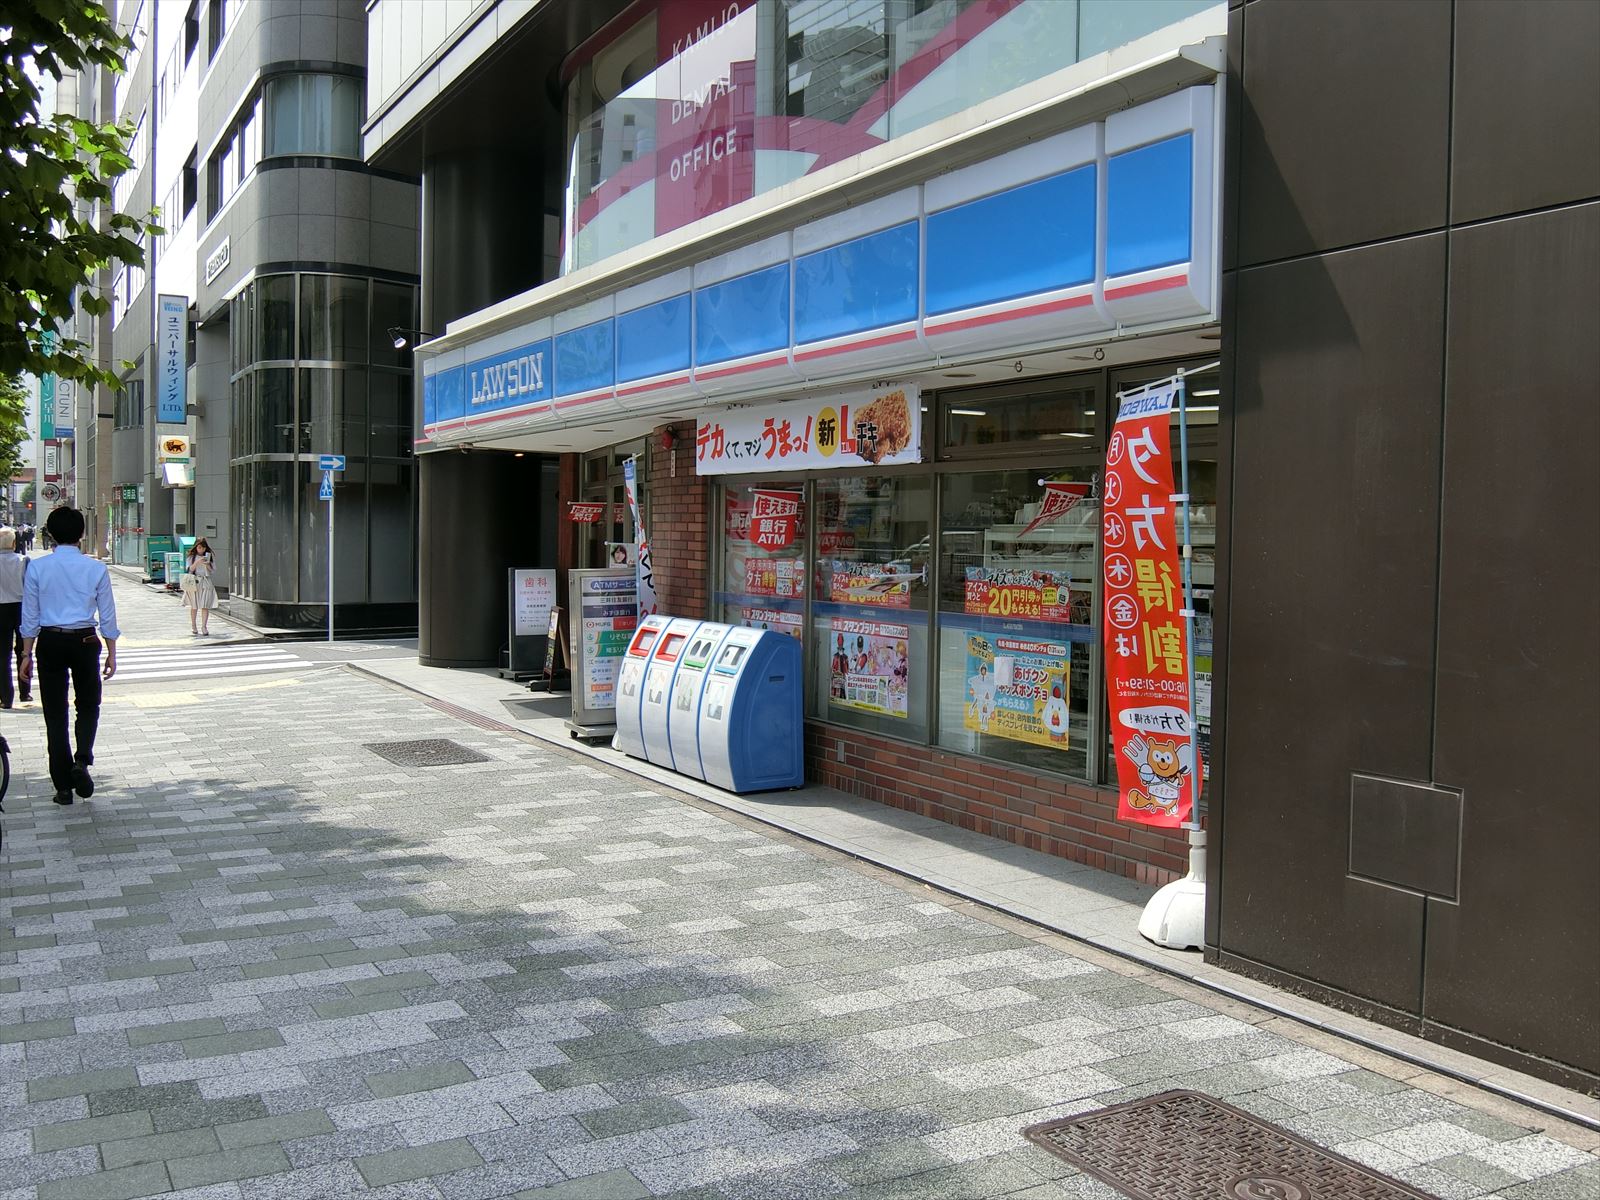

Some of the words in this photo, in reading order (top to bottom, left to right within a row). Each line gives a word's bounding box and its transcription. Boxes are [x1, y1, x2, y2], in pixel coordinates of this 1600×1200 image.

[672, 2, 739, 64] KAMIJO
[671, 69, 737, 125] DENTAL
[670, 127, 737, 182] OFFICE
[167, 316, 179, 402] ユニバーサルウィング
[471, 351, 543, 405] LAWSON
[818, 418, 836, 447] 新
[755, 496, 796, 516] 使えます!
[757, 533, 786, 545] ATM
[759, 519, 788, 533] 銀行
[525, 577, 548, 588] 歯科
[751, 609, 780, 622] スタンプラリー
[988, 588, 1012, 616] 20
[843, 620, 880, 635] スタンプラリー
